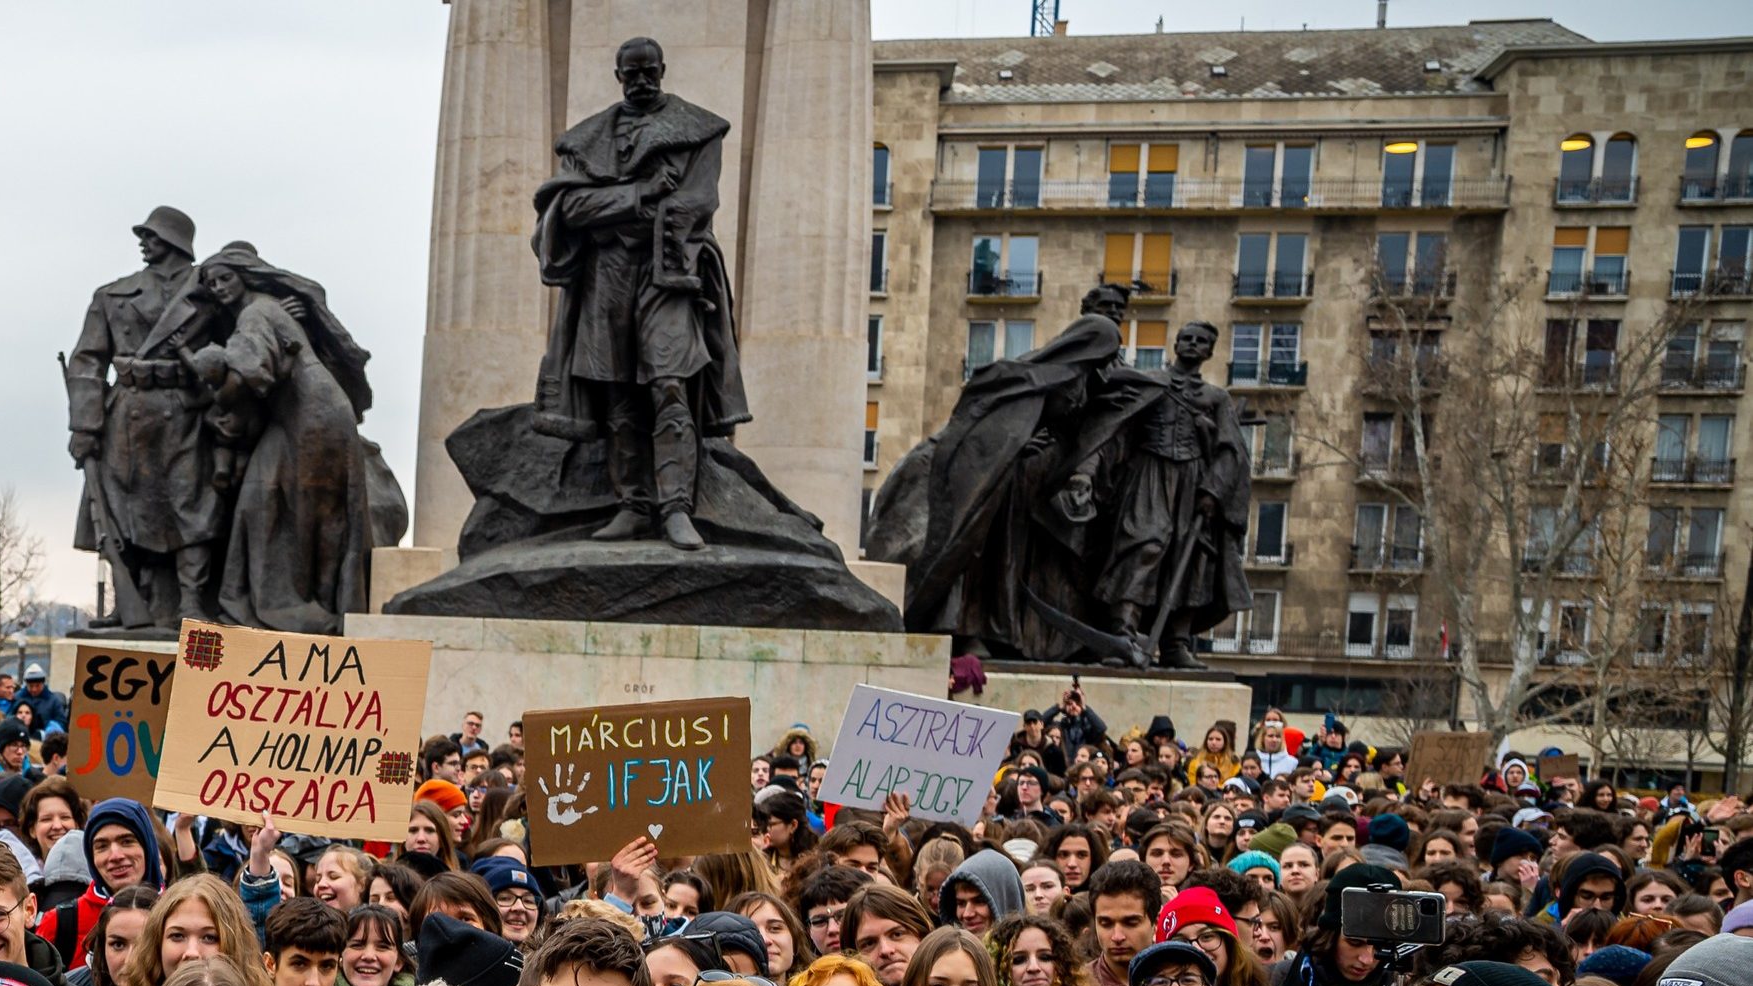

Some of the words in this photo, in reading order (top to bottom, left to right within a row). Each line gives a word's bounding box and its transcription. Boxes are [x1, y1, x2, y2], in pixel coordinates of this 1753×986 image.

[82, 655, 177, 705] EGY
[248, 640, 288, 681] A
[298, 643, 365, 685] MA
[206, 681, 388, 736] OSZTÁLYA,
[198, 726, 239, 766] A
[248, 730, 383, 776] HOLNAP
[550, 714, 729, 755] MÁRCIUSI
[199, 769, 376, 824] ORSZÁGA
[607, 757, 714, 812] IFJAK
